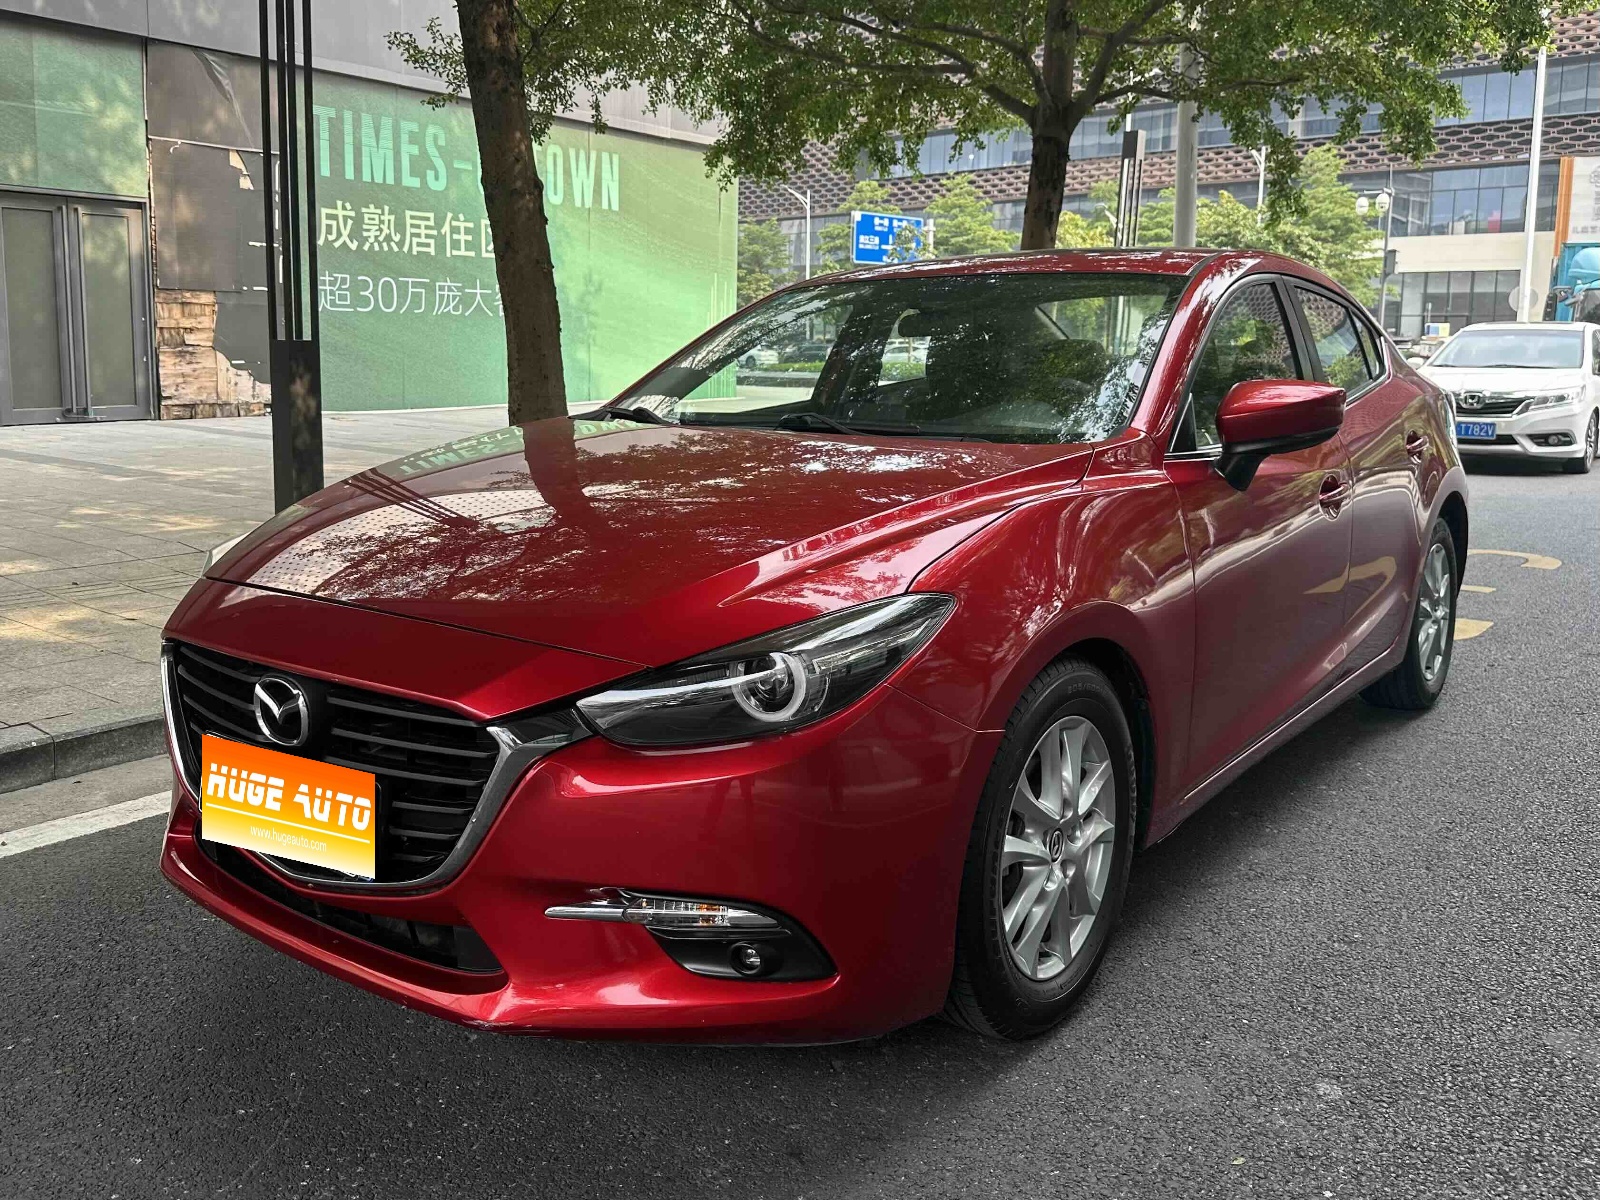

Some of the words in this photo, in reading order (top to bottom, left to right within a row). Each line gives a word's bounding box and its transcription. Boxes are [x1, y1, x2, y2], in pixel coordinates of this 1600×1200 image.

[313, 105, 485, 192] TIMES-
[533, 144, 620, 211] OWN
[1460, 424, 1494, 436] T782V
